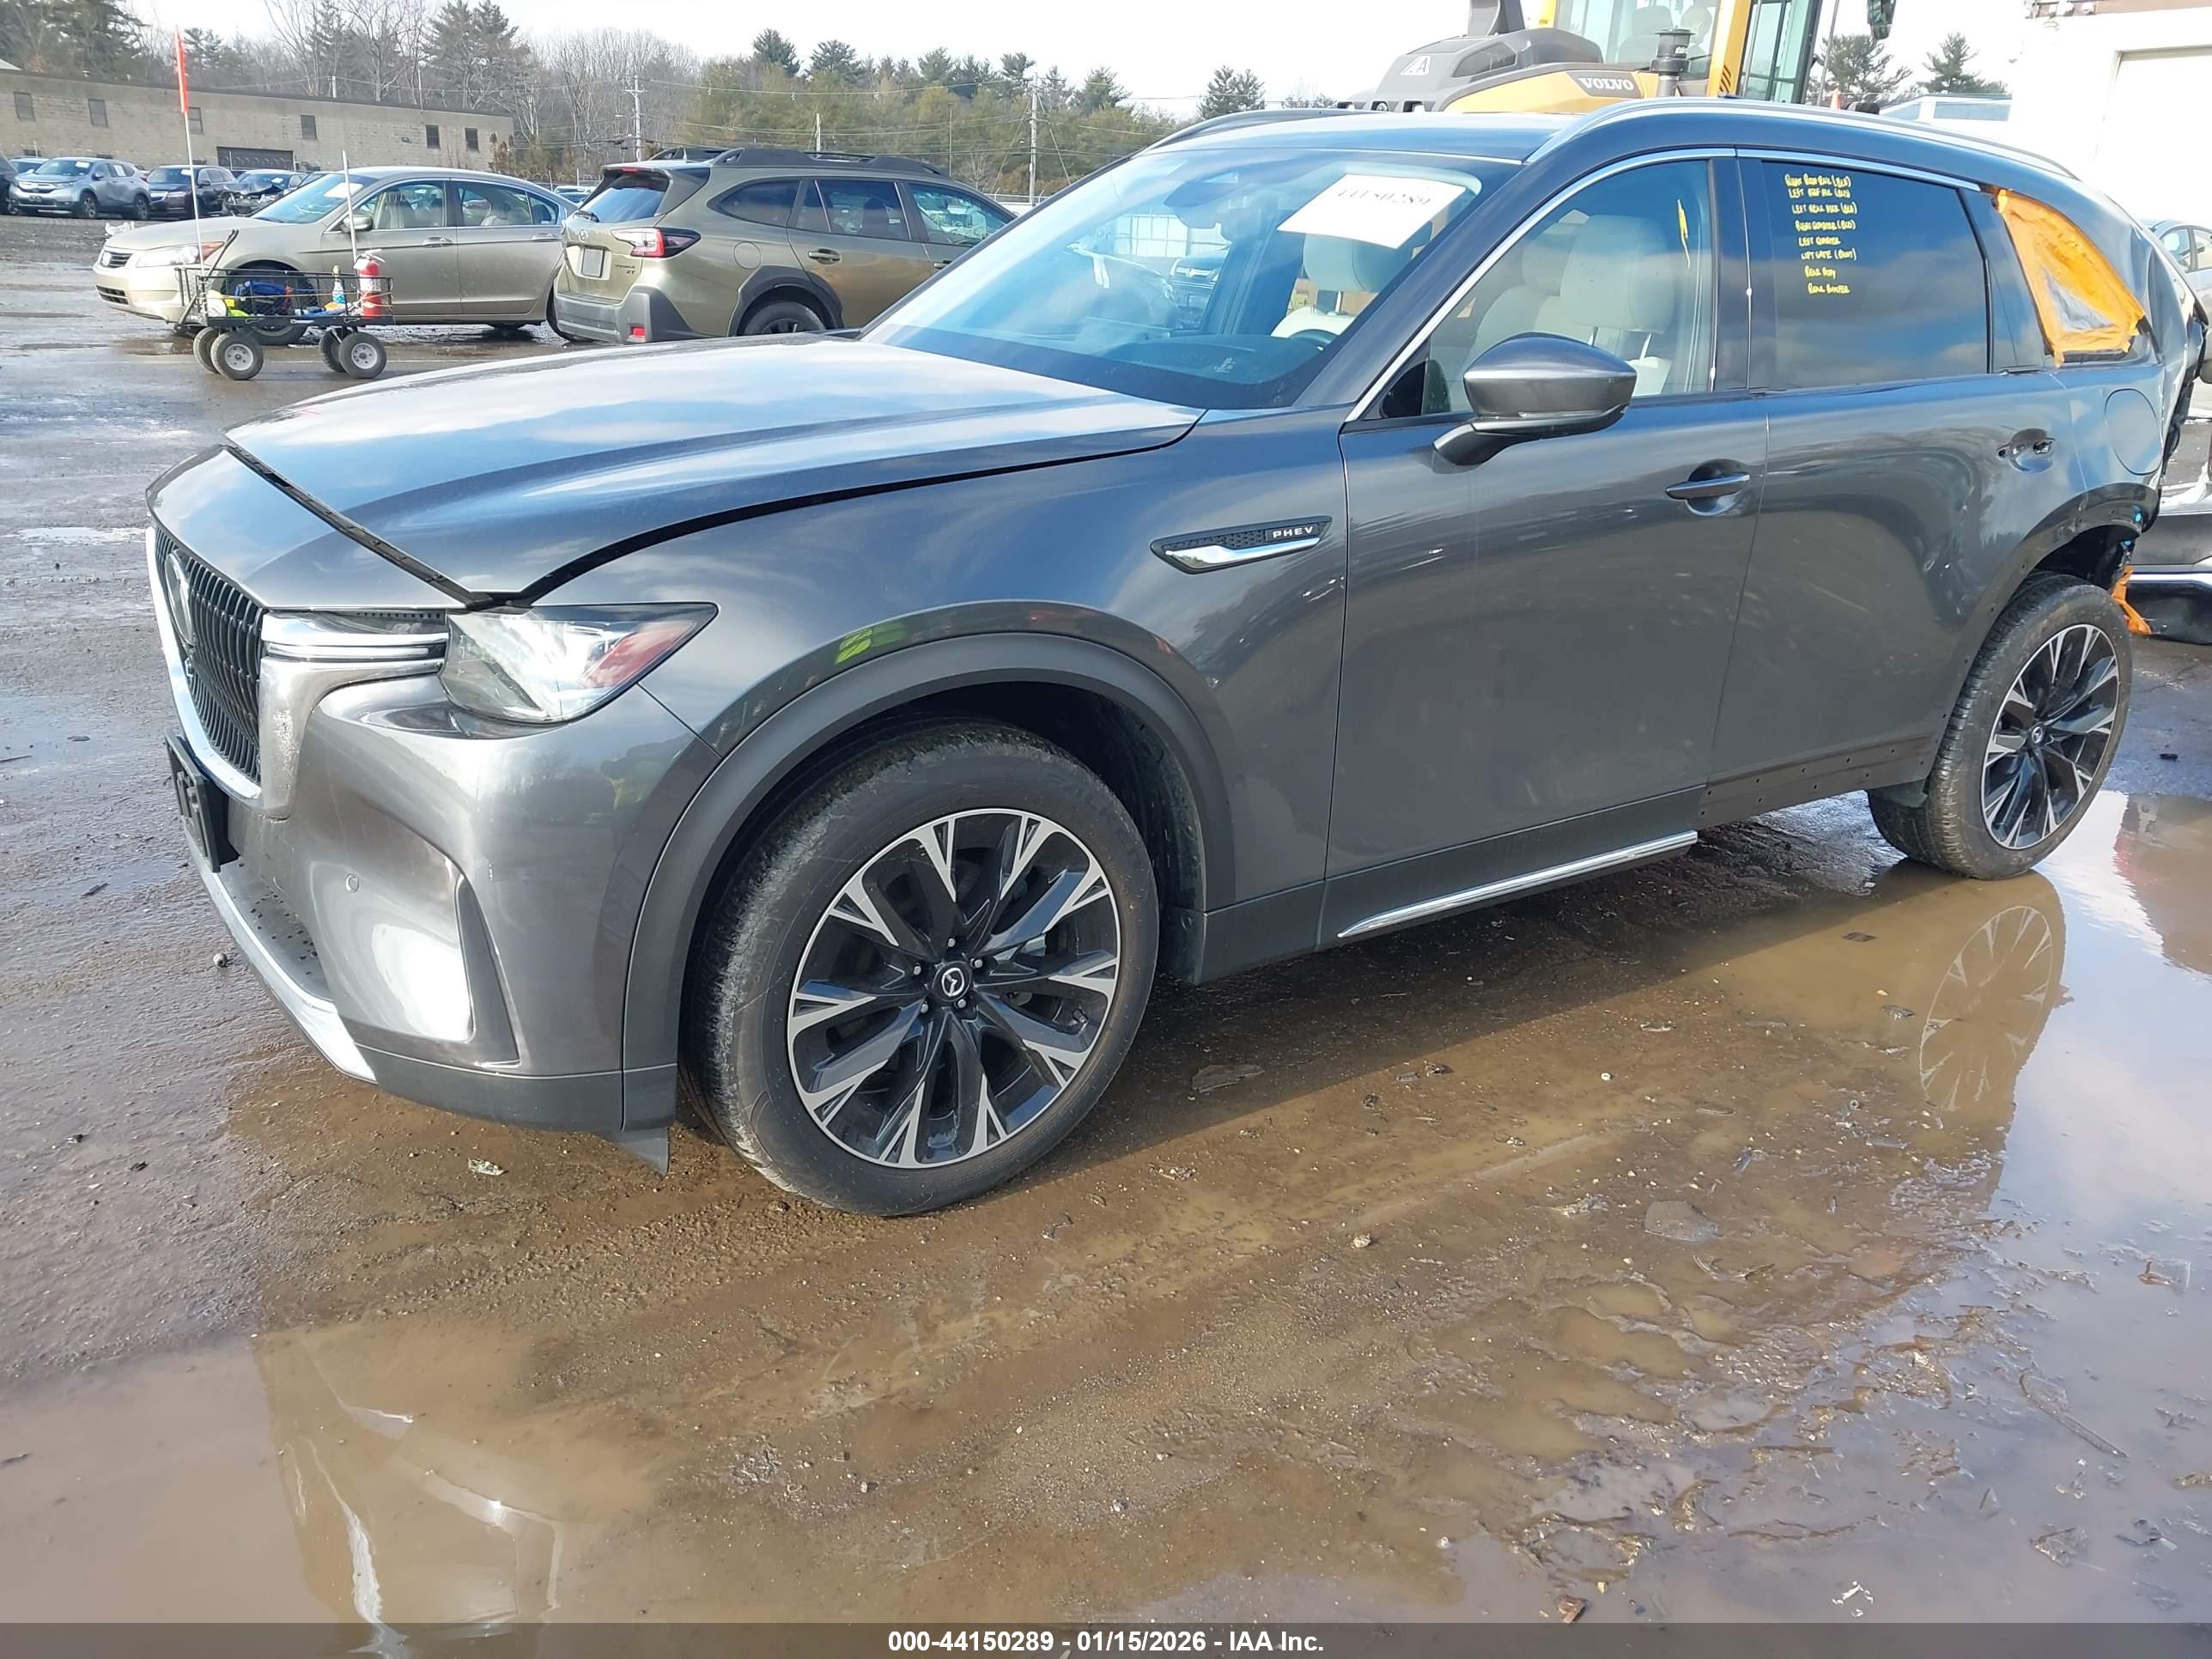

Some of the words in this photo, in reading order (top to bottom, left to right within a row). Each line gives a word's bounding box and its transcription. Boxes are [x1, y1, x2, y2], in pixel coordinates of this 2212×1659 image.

[1578, 77, 1634, 90] VOLVO
[1789, 188, 1804, 198] LEFT
[1792, 204, 1807, 214] LEFT
[1798, 237, 1814, 246] LEFT
[1273, 526, 1313, 538] PHEV
